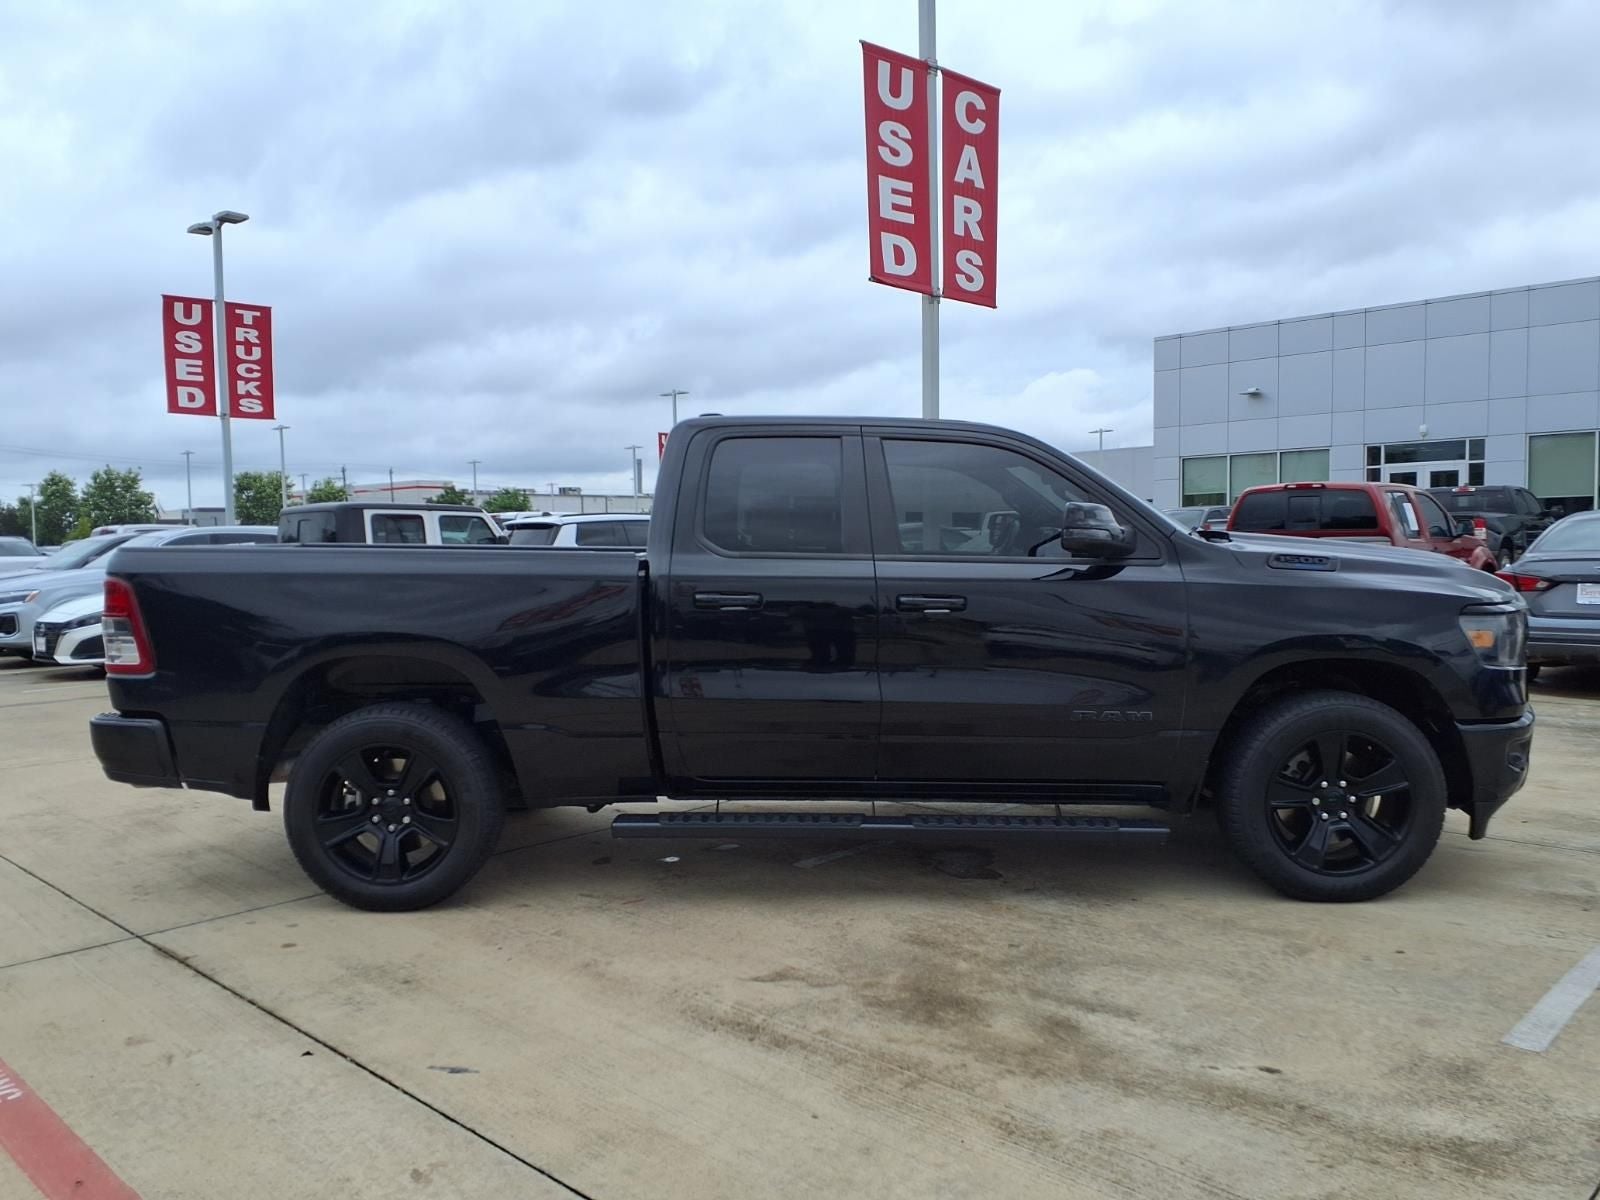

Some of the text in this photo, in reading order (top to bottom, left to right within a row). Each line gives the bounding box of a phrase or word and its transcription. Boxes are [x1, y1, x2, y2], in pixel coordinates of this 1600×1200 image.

[877, 60, 917, 277] USED
[953, 90, 986, 292] CARS
[173, 301, 206, 408] USED
[234, 308, 264, 413] TRUCKS
[1277, 554, 1328, 564] 1500
[1071, 709, 1153, 721] RAM
